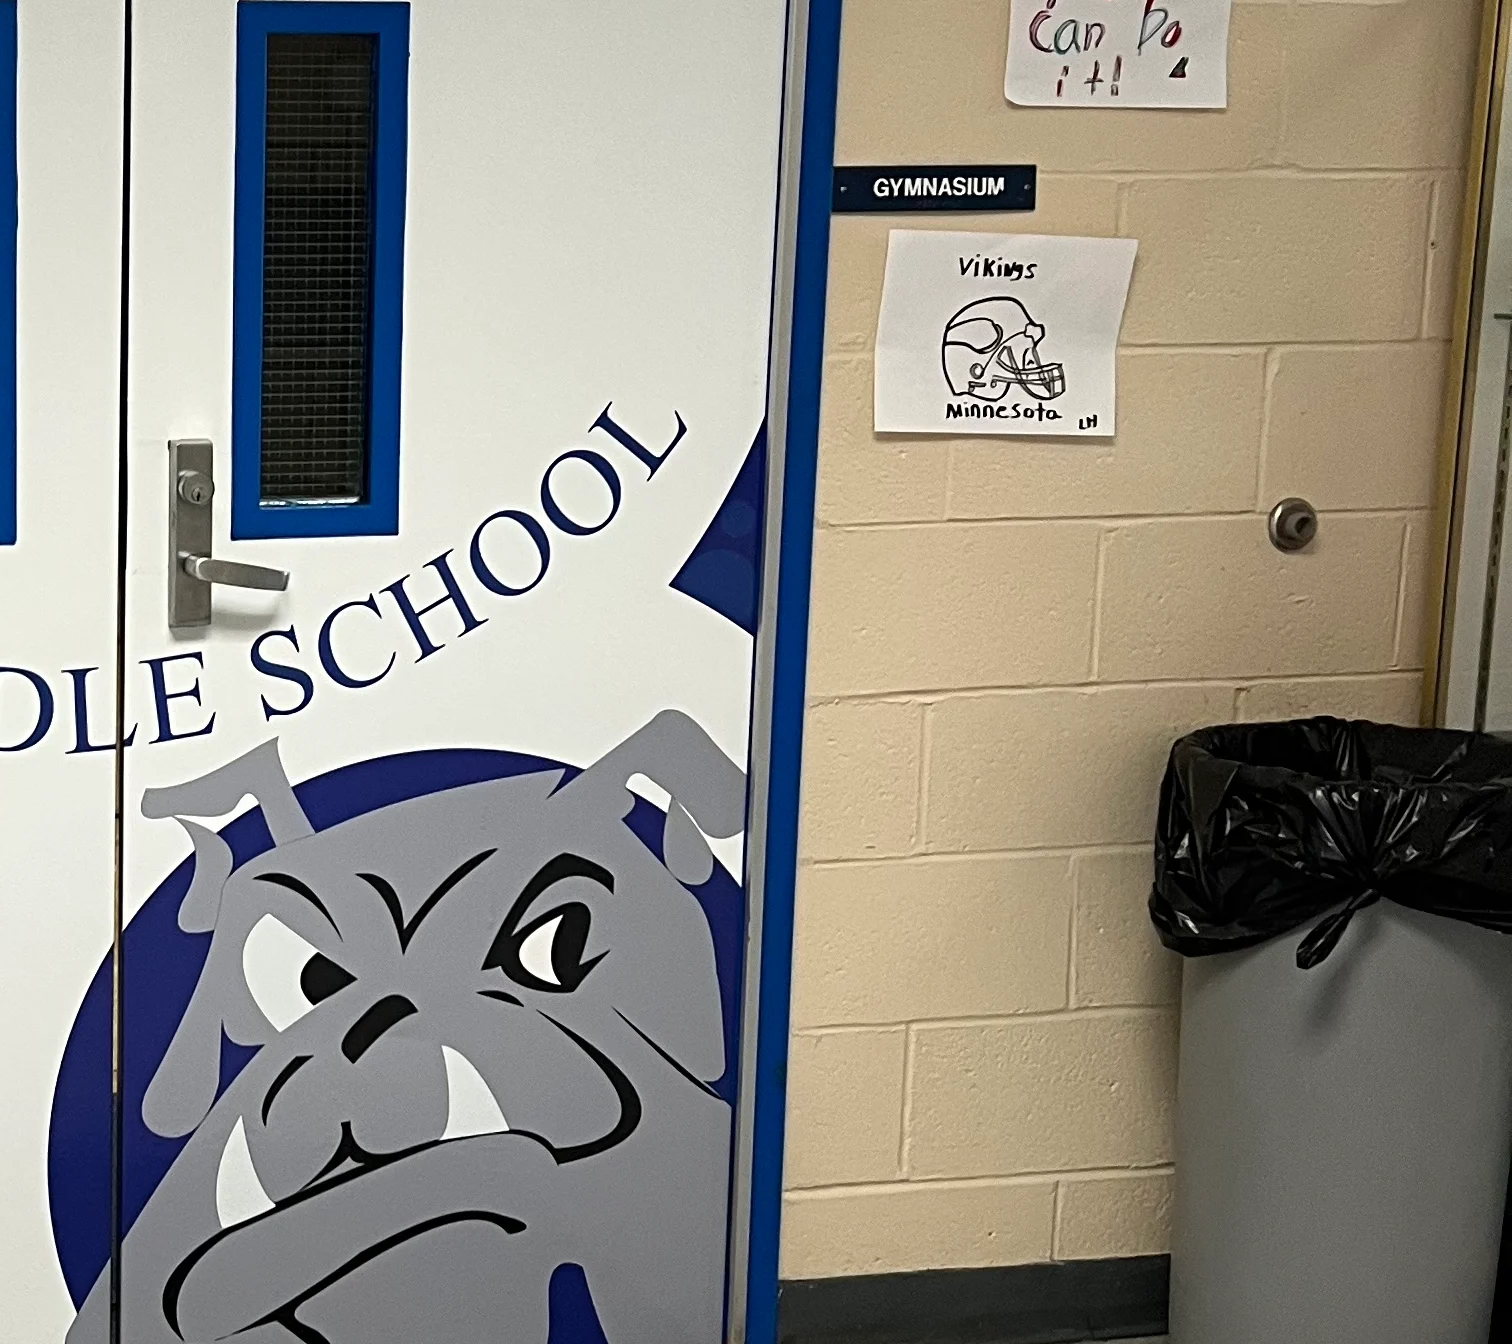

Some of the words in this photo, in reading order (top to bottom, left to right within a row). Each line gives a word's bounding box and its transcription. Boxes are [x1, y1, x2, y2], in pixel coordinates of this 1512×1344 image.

[873, 176, 1005, 197] GYMNASIUM
[945, 401, 1063, 422] Minnesota
[249, 400, 688, 723] SCHOOL
